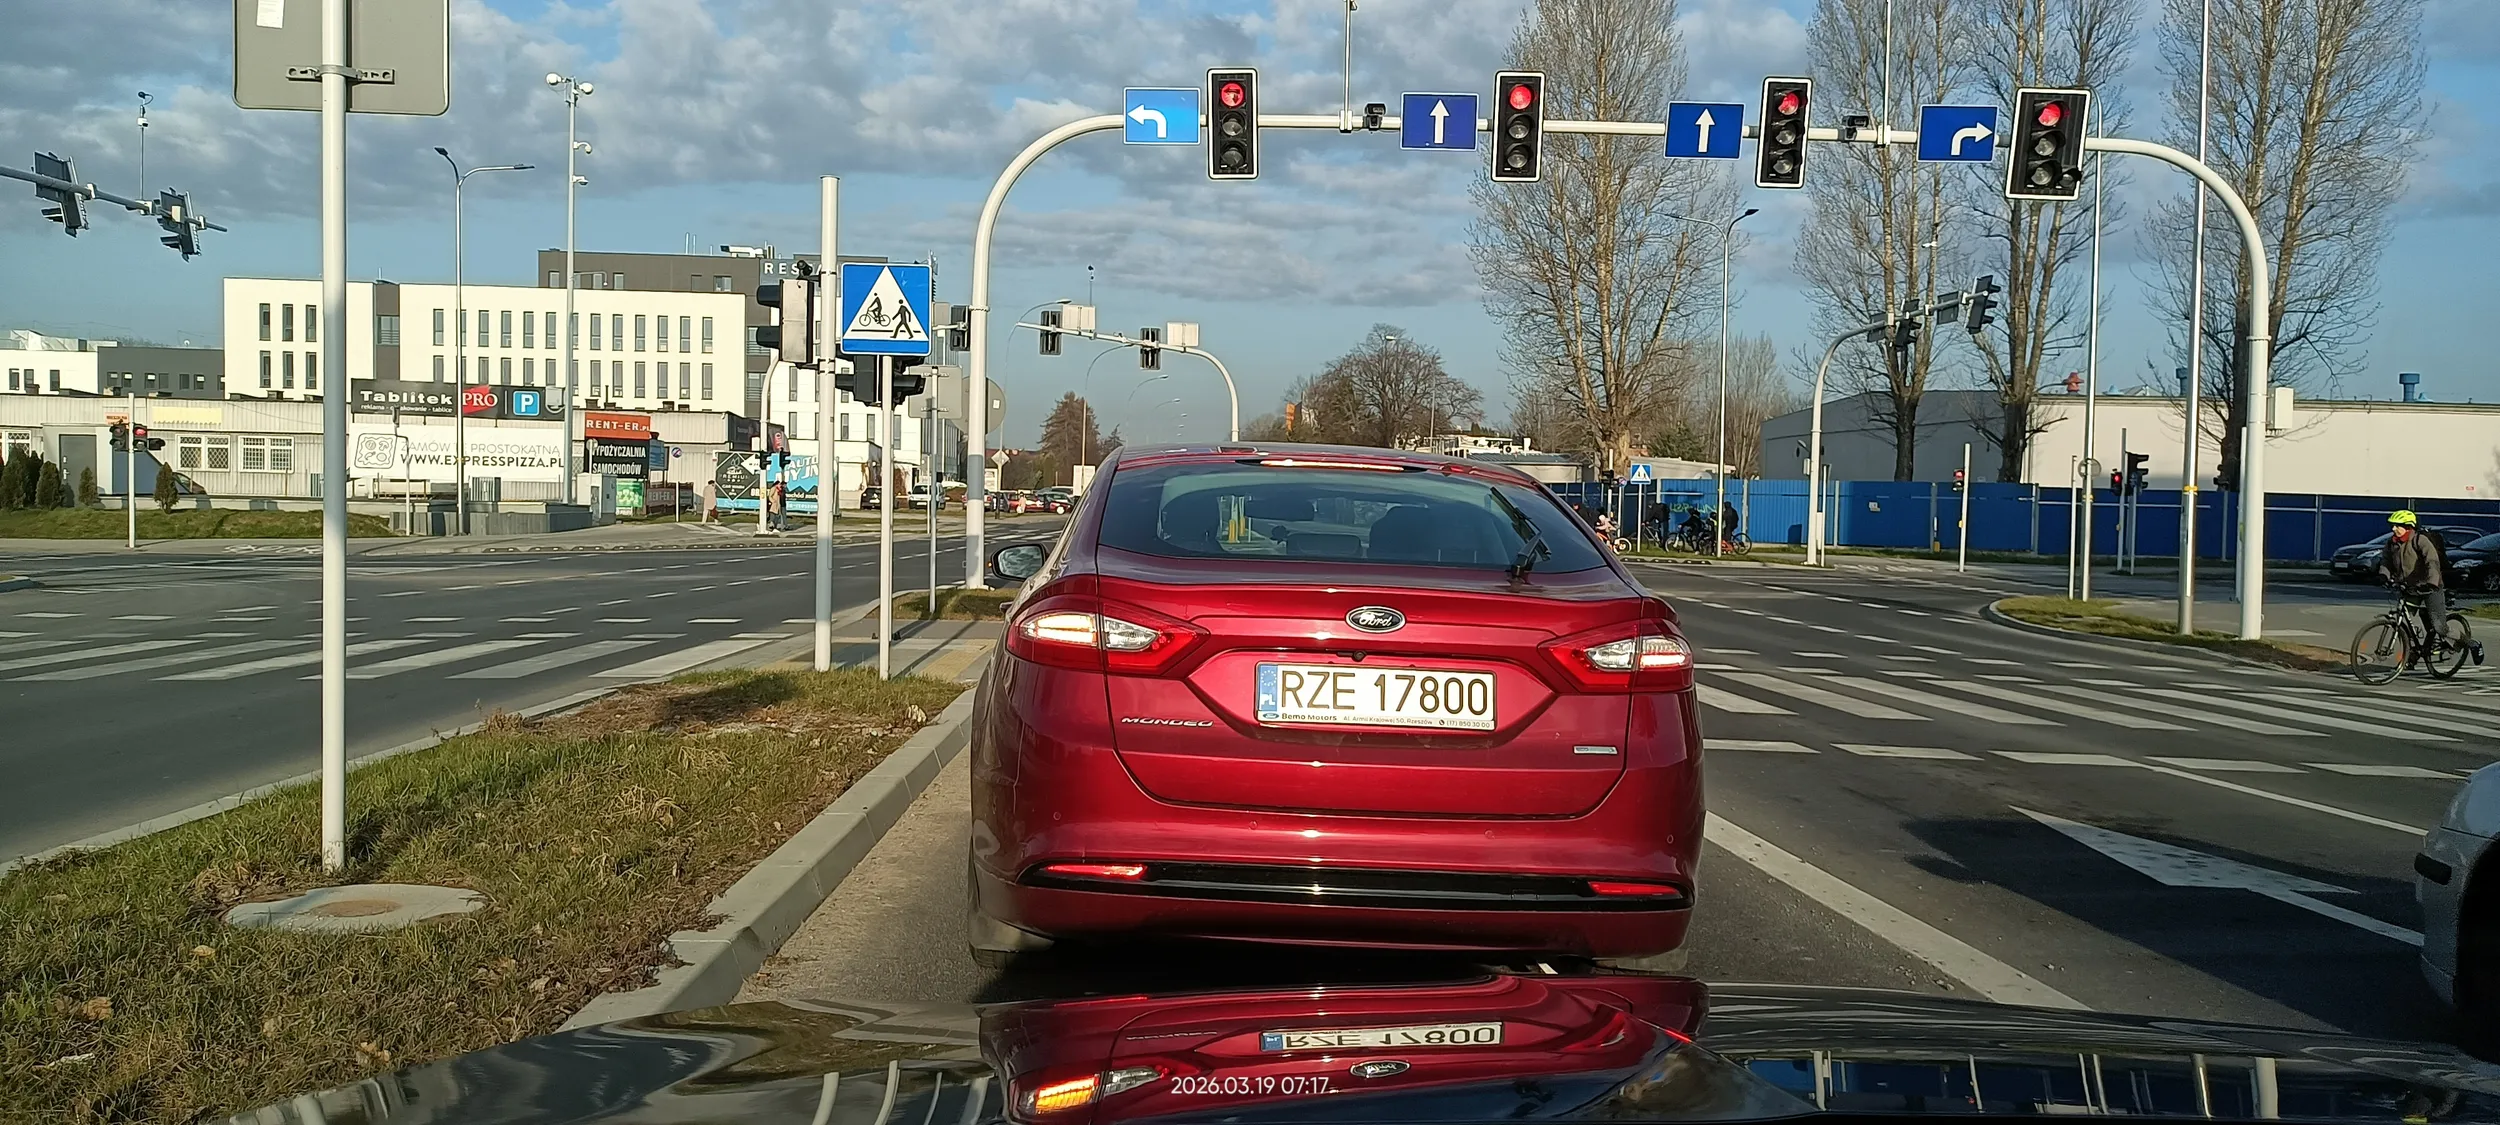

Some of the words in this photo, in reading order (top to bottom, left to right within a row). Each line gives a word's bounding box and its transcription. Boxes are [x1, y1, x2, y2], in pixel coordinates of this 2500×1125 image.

[360, 391, 453, 405] Tablitek
[462, 393, 498, 407] PRO
[592, 462, 642, 475] SAMOCHODÓW
[1360, 611, 1393, 627] Ford
[1282, 670, 1356, 711] RZE
[1374, 673, 1488, 716] 17800
[1121, 717, 1214, 727] MONDEO
[1281, 712, 1306, 720] Bemo
